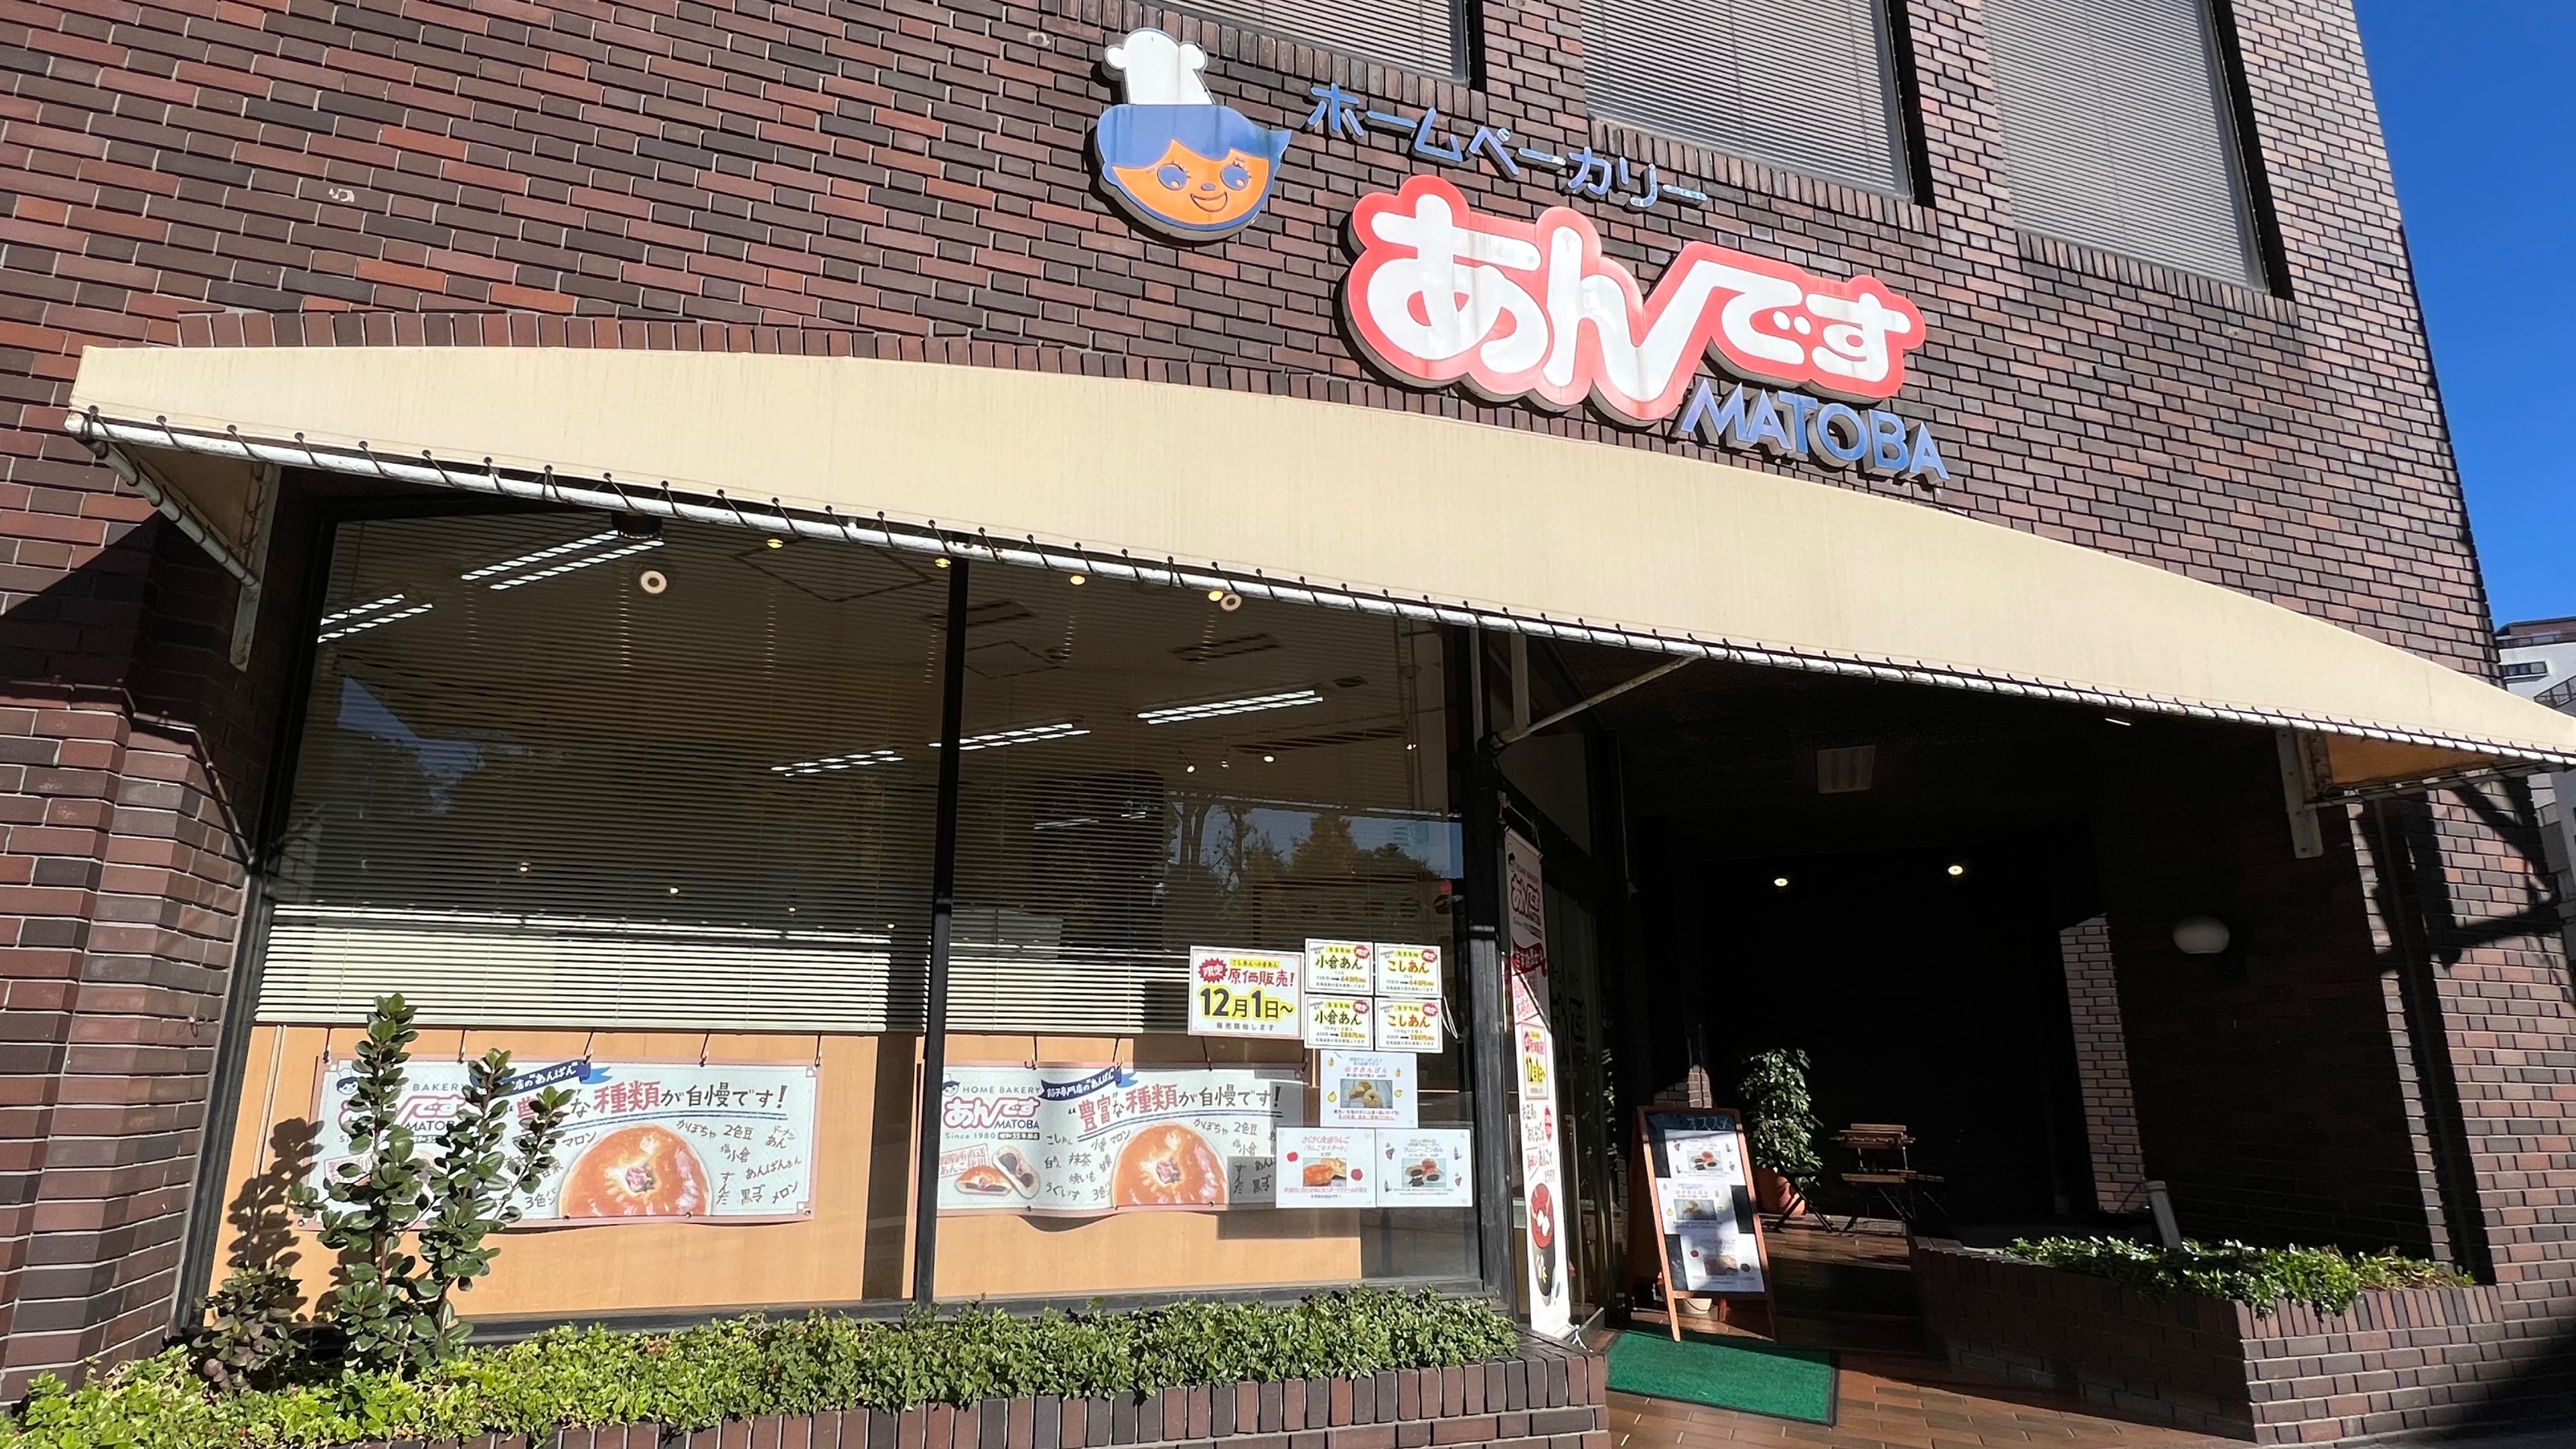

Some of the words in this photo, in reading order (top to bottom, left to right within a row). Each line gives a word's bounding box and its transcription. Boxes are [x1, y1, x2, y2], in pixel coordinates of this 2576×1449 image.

[1365, 190, 1911, 403] あんです
[1679, 378, 1950, 481] MATOBA
[1202, 964, 1224, 977] 限定
[1315, 955, 1363, 970] 小倉あん
[1388, 960, 1429, 973] こしあん
[1314, 1009, 1362, 1025] 小倉あん
[1388, 1014, 1430, 1027] こしあん
[1216, 1022, 1274, 1031] 販売開始します
[944, 1097, 1040, 1128] あんです
[404, 1121, 457, 1131] MATO
[676, 1119, 717, 1138] かぼちゃ
[723, 1124, 754, 1140] 2色豆
[994, 1119, 1040, 1129] MATOBA
[1194, 1118, 1228, 1135] かぼちゃ
[1234, 1121, 1257, 1136] 2色豆
[1686, 1115, 1731, 1131] オススメ
[562, 1131, 597, 1148] マロン
[1046, 1134, 1073, 1145] こしあん
[1110, 1130, 1131, 1144] マロン
[746, 1156, 802, 1180] あんぱんまん
[1044, 1156, 1062, 1169] 白あん
[1068, 1153, 1091, 1167] 抹茶
[1069, 1171, 1096, 1184] 焼いも
[772, 1181, 798, 1204] メロン
